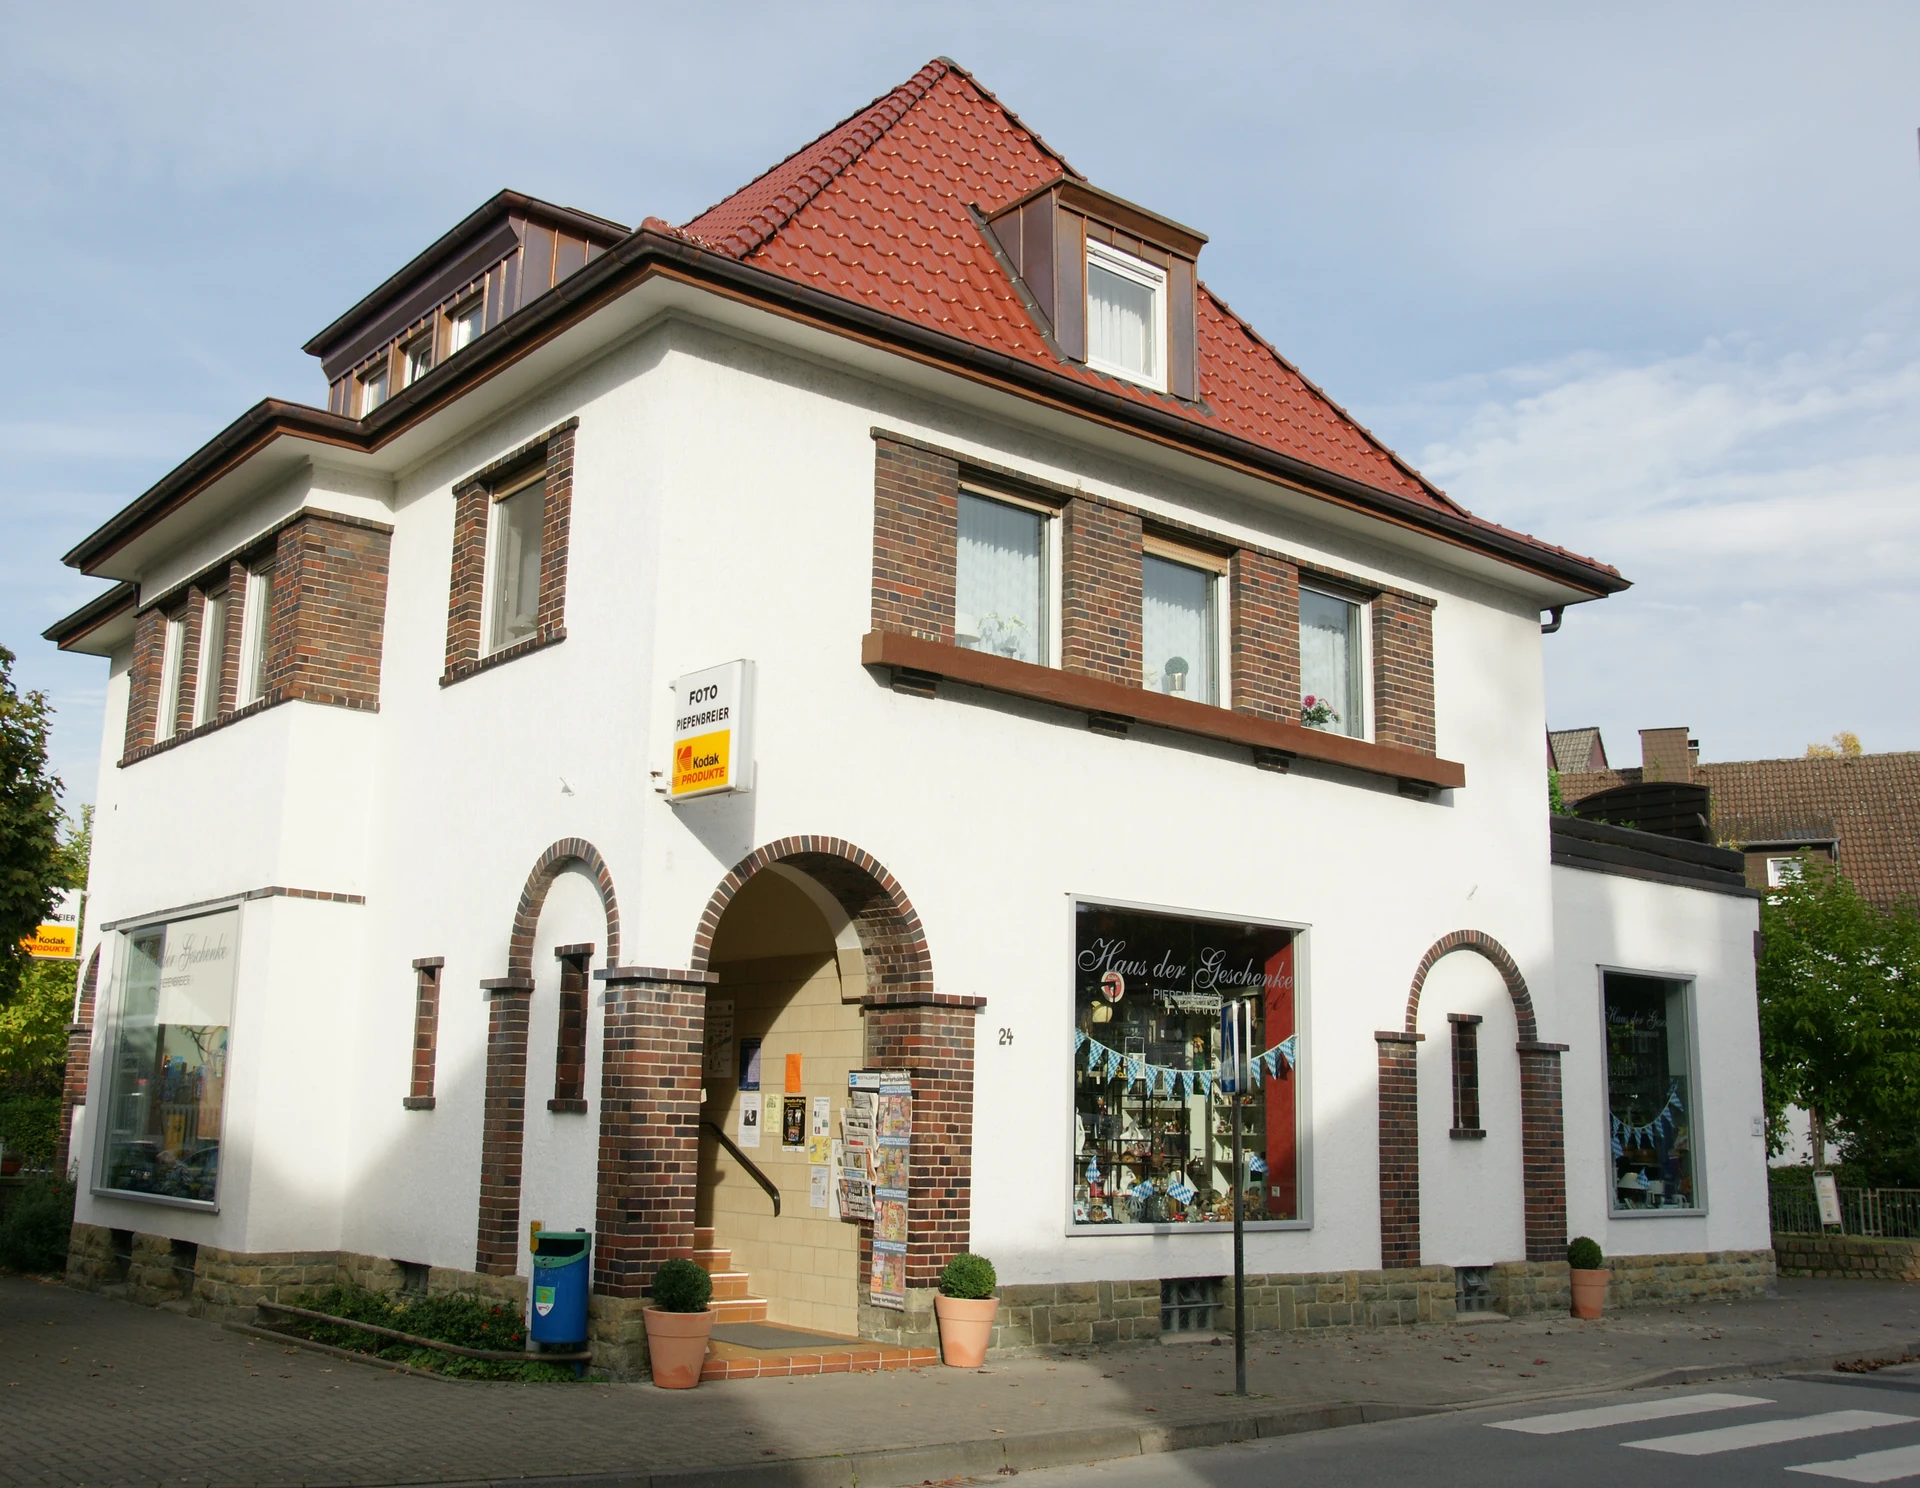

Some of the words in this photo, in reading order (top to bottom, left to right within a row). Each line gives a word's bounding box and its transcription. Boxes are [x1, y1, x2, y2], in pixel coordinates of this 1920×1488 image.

[689, 684, 718, 705] FOTO
[676, 707, 729, 731] PIEPENBREIER
[693, 752, 719, 769] Kodak
[682, 766, 725, 785] PRODUKTE
[31, 944, 71, 953] RODUKTE
[39, 936, 66, 945] Kodak
[1078, 938, 1148, 972] Haus
[1153, 949, 1186, 979] der
[1195, 947, 1294, 990] Geschenke
[998, 1027, 1014, 1046] 24
